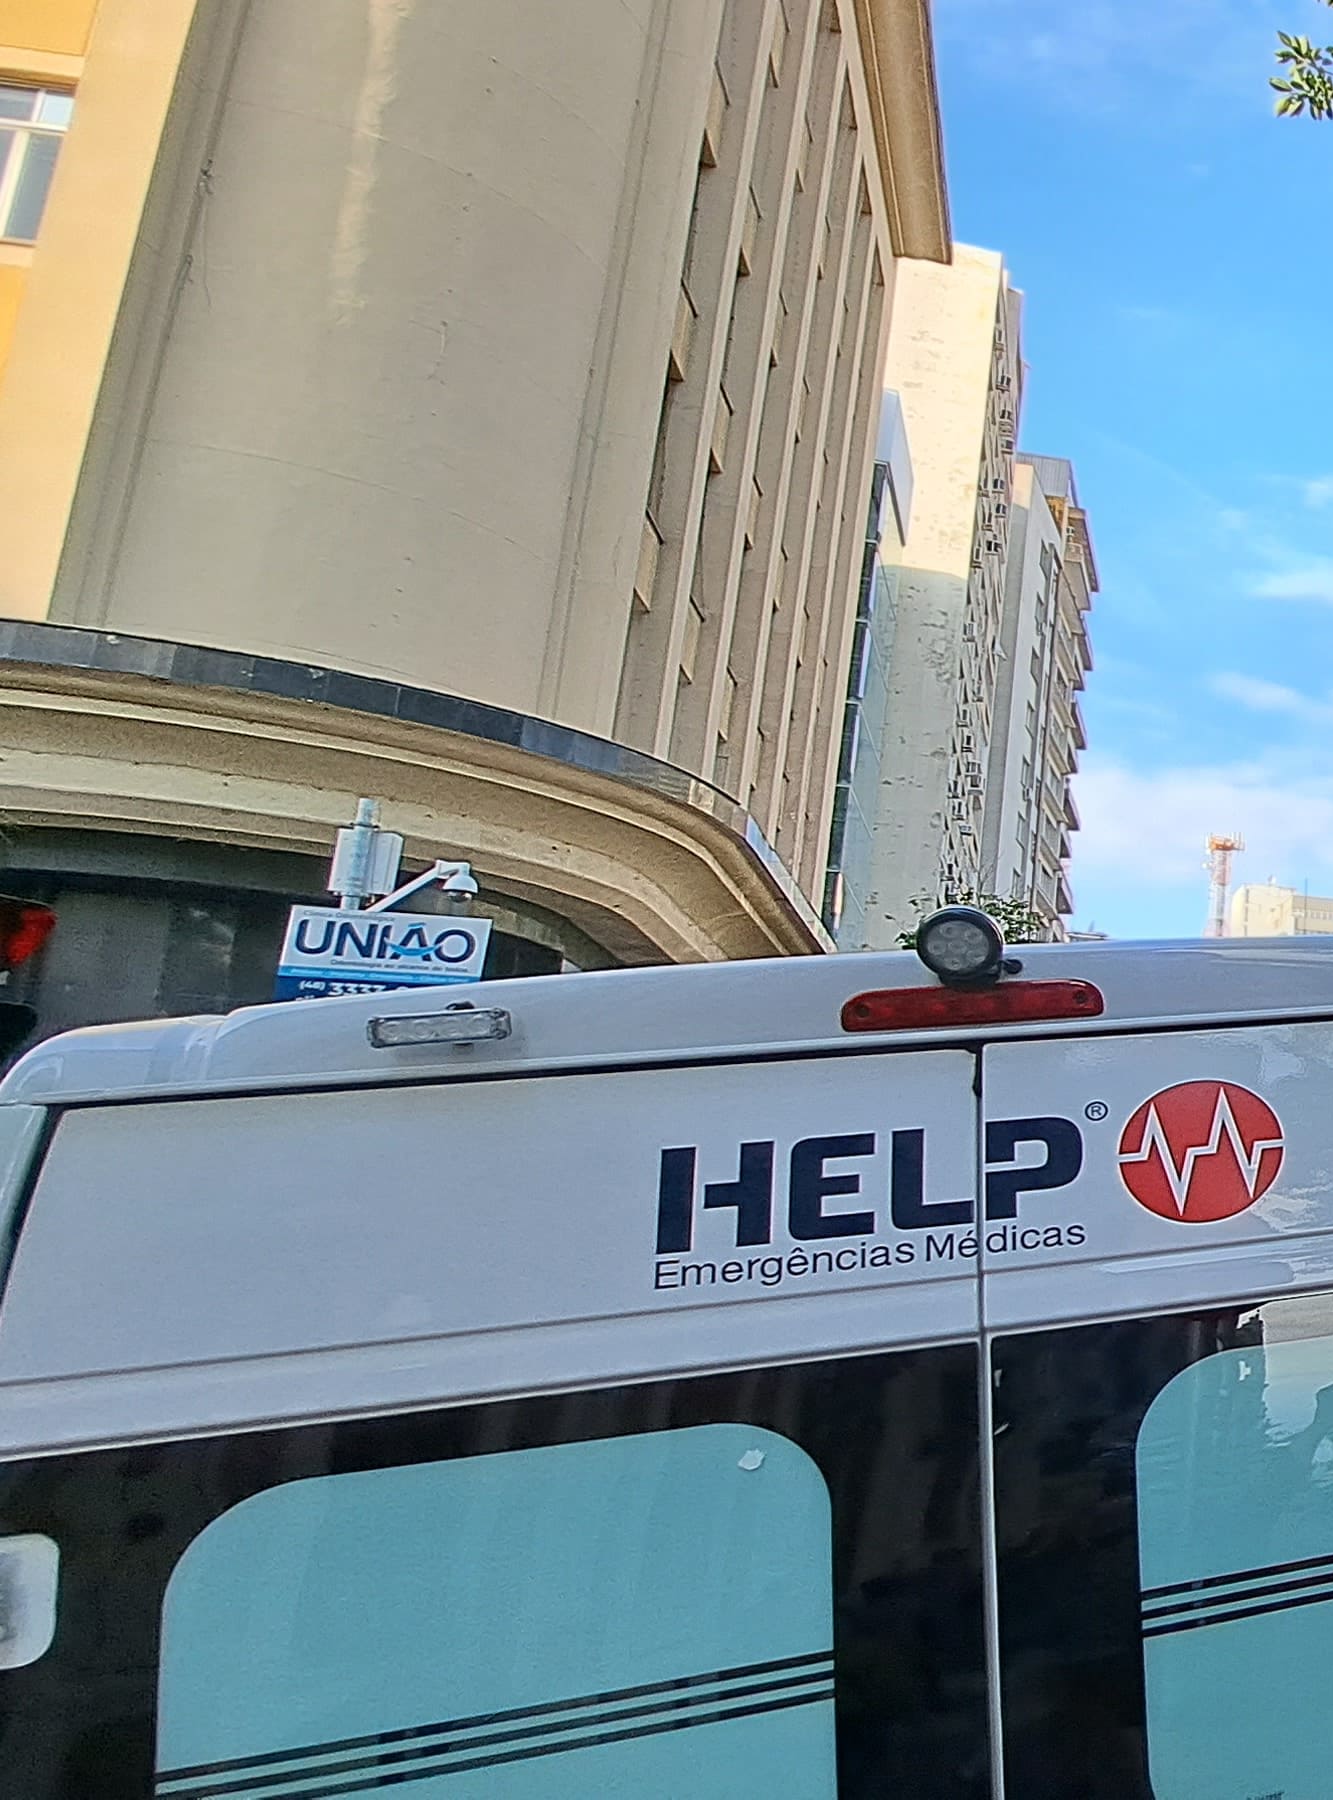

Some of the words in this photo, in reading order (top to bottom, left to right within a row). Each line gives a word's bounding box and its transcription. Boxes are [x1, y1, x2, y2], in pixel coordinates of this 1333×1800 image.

[295, 919, 476, 963] UNIÃO
[654, 1116, 1083, 1255] HELP
[653, 1240, 915, 1289] Emergências
[925, 1225, 1086, 1262] Médicas
